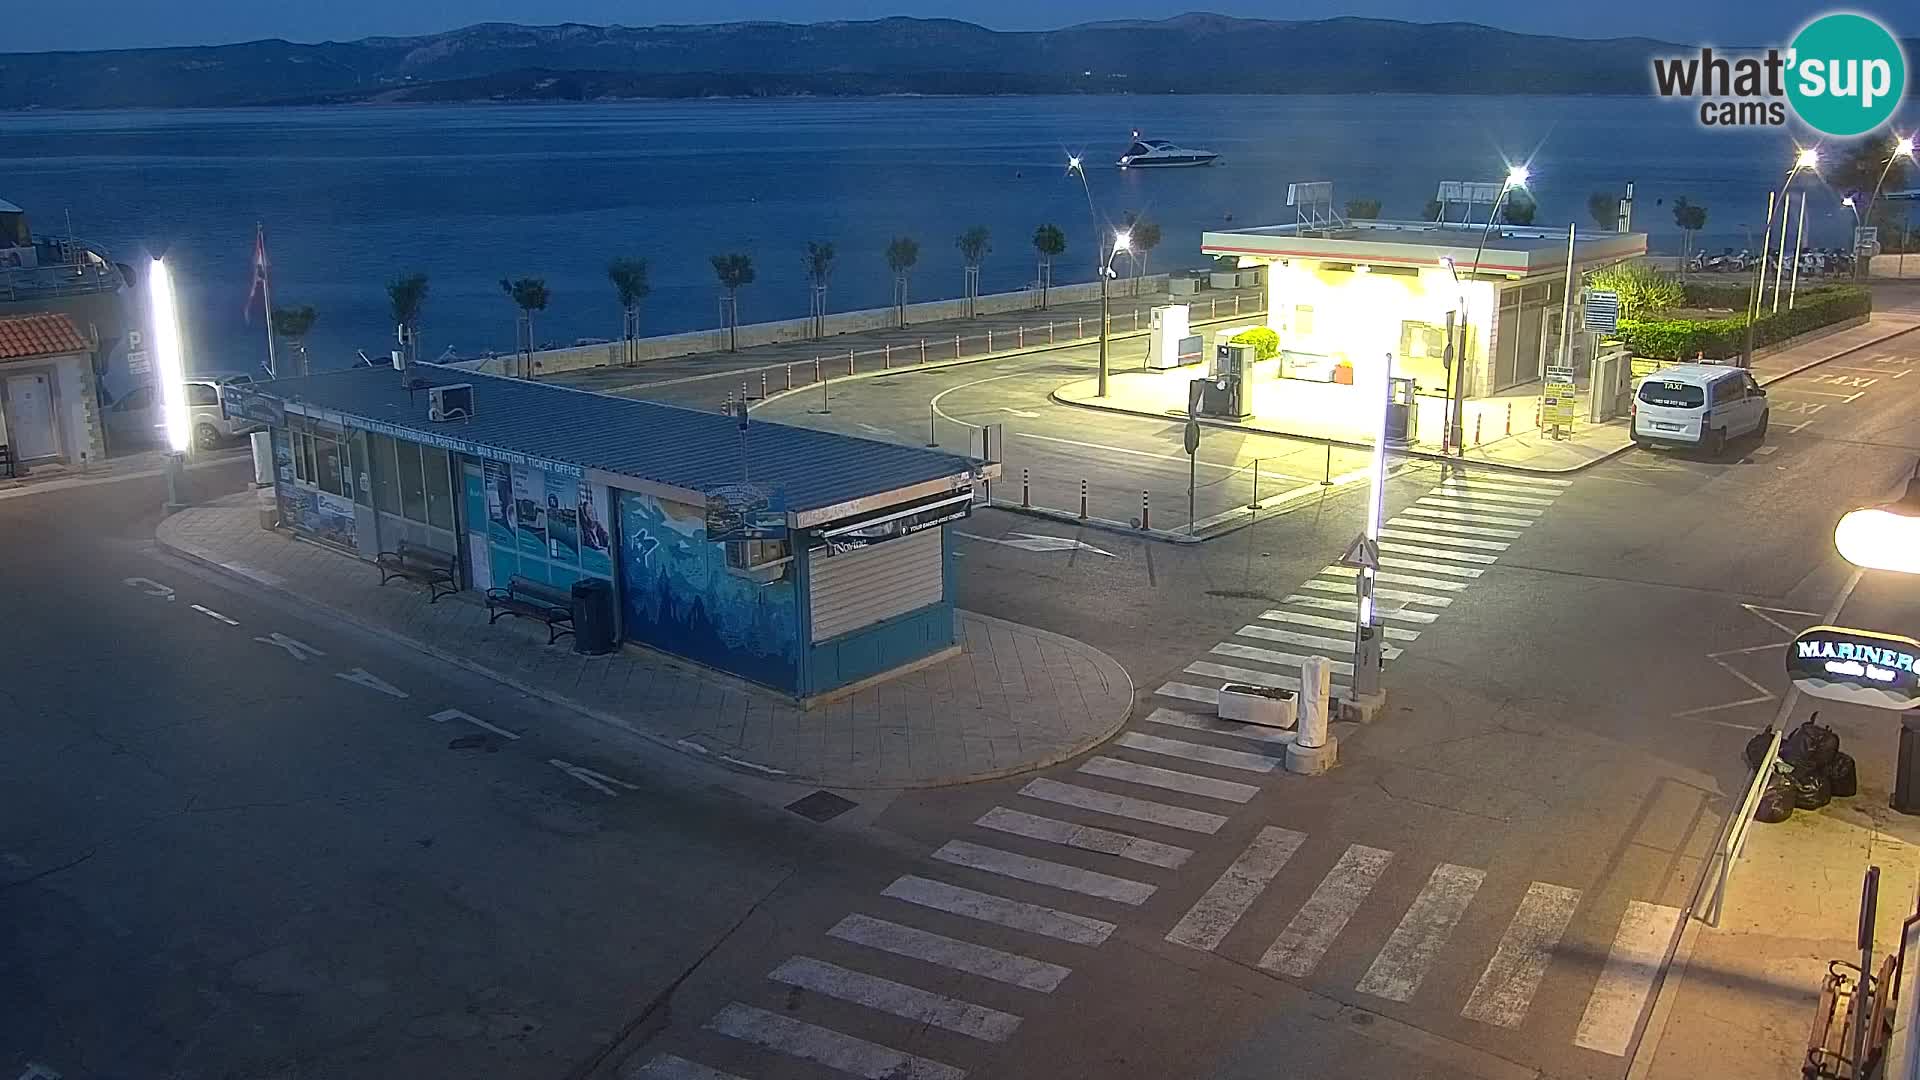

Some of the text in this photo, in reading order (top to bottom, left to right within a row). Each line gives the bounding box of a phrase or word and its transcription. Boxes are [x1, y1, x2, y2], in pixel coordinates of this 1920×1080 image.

[1810, 374, 1879, 387] TAXI
[435, 436, 466, 451] POSTAJA
[477, 446, 491, 457] BUS
[493, 449, 525, 464] STATION
[528, 457, 554, 471] TICKET
[554, 463, 581, 477] OFFICE
